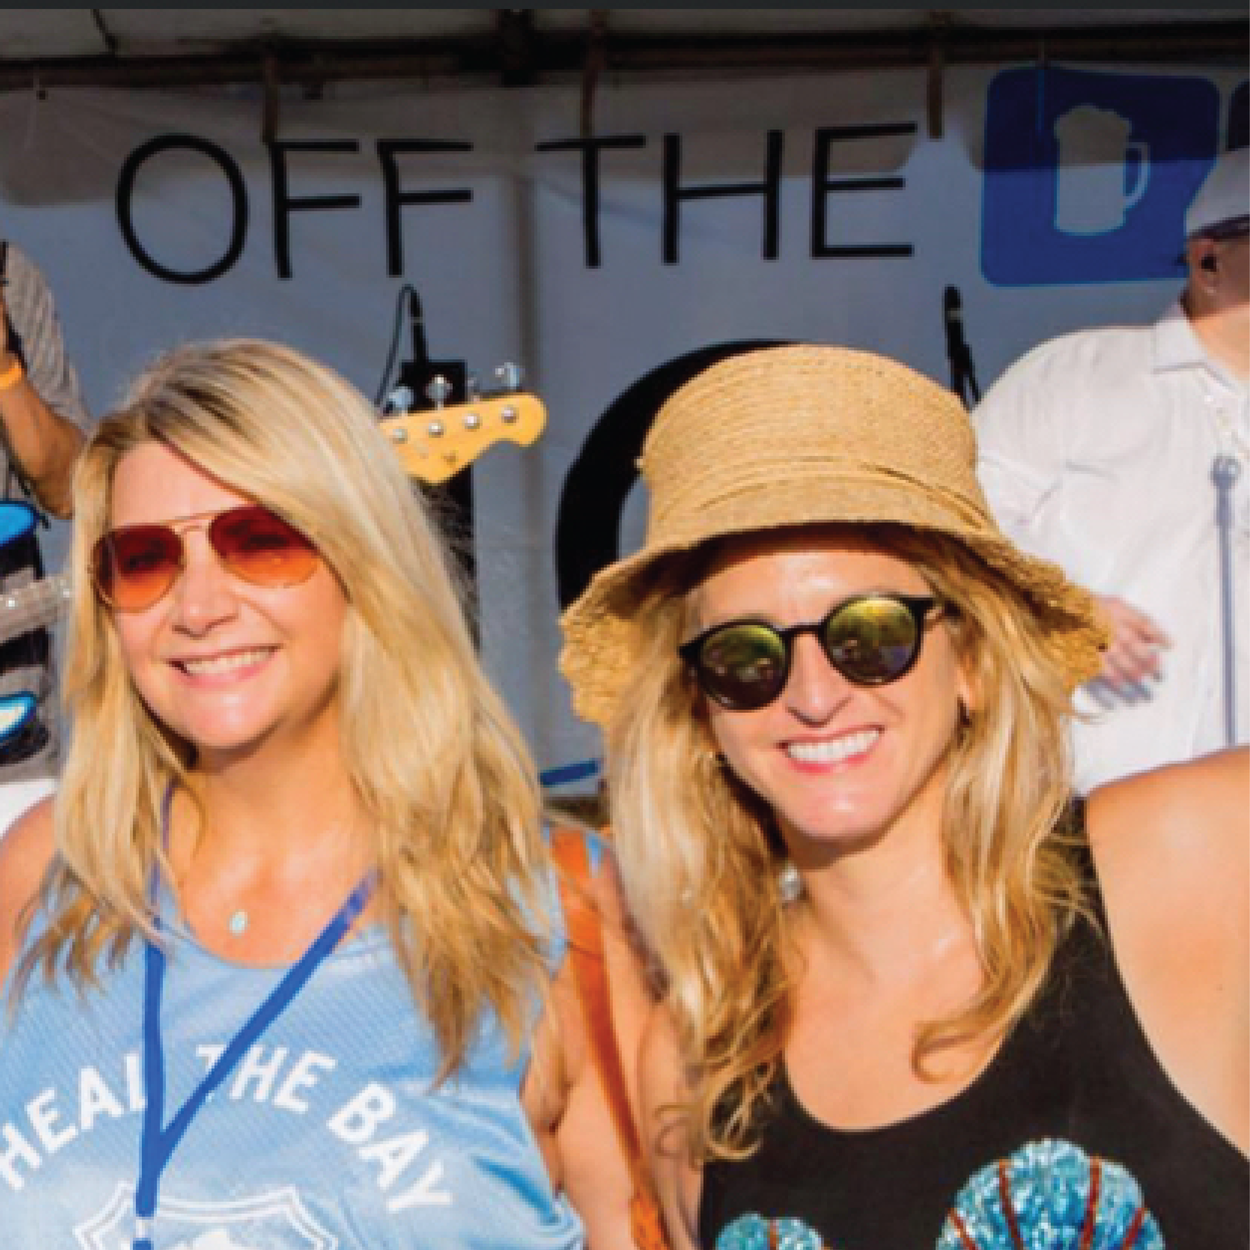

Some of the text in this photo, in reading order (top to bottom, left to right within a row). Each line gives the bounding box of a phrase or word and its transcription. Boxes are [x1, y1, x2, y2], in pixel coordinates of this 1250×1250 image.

[114, 122, 917, 285] OFF THE
[326, 1082, 453, 1213] BAY
